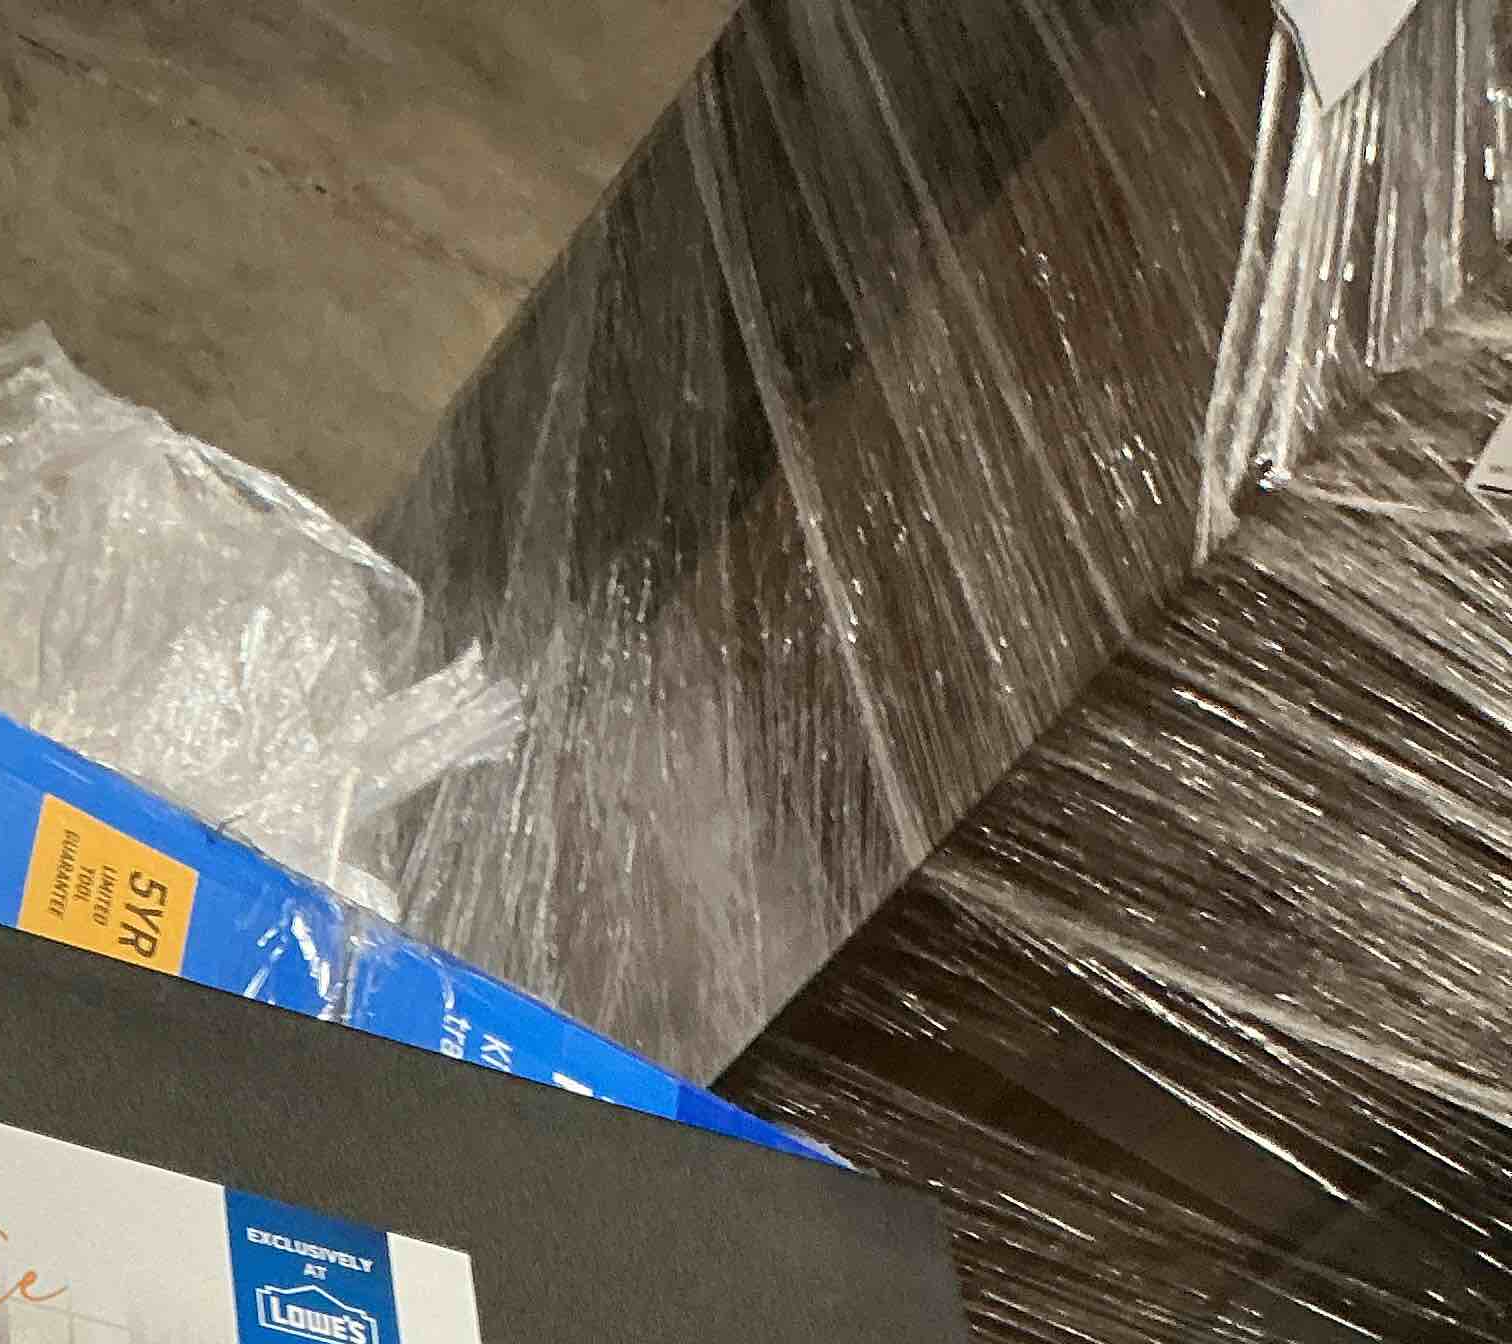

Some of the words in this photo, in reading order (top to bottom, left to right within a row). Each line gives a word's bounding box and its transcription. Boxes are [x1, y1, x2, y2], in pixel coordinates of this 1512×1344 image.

[47, 827, 81, 921] GUARANTEE
[92, 863, 119, 927] LIMITED
[117, 870, 169, 959] 5YR
[245, 1226, 375, 1273] EXCLUSIVELY
[303, 1262, 329, 1281] AT
